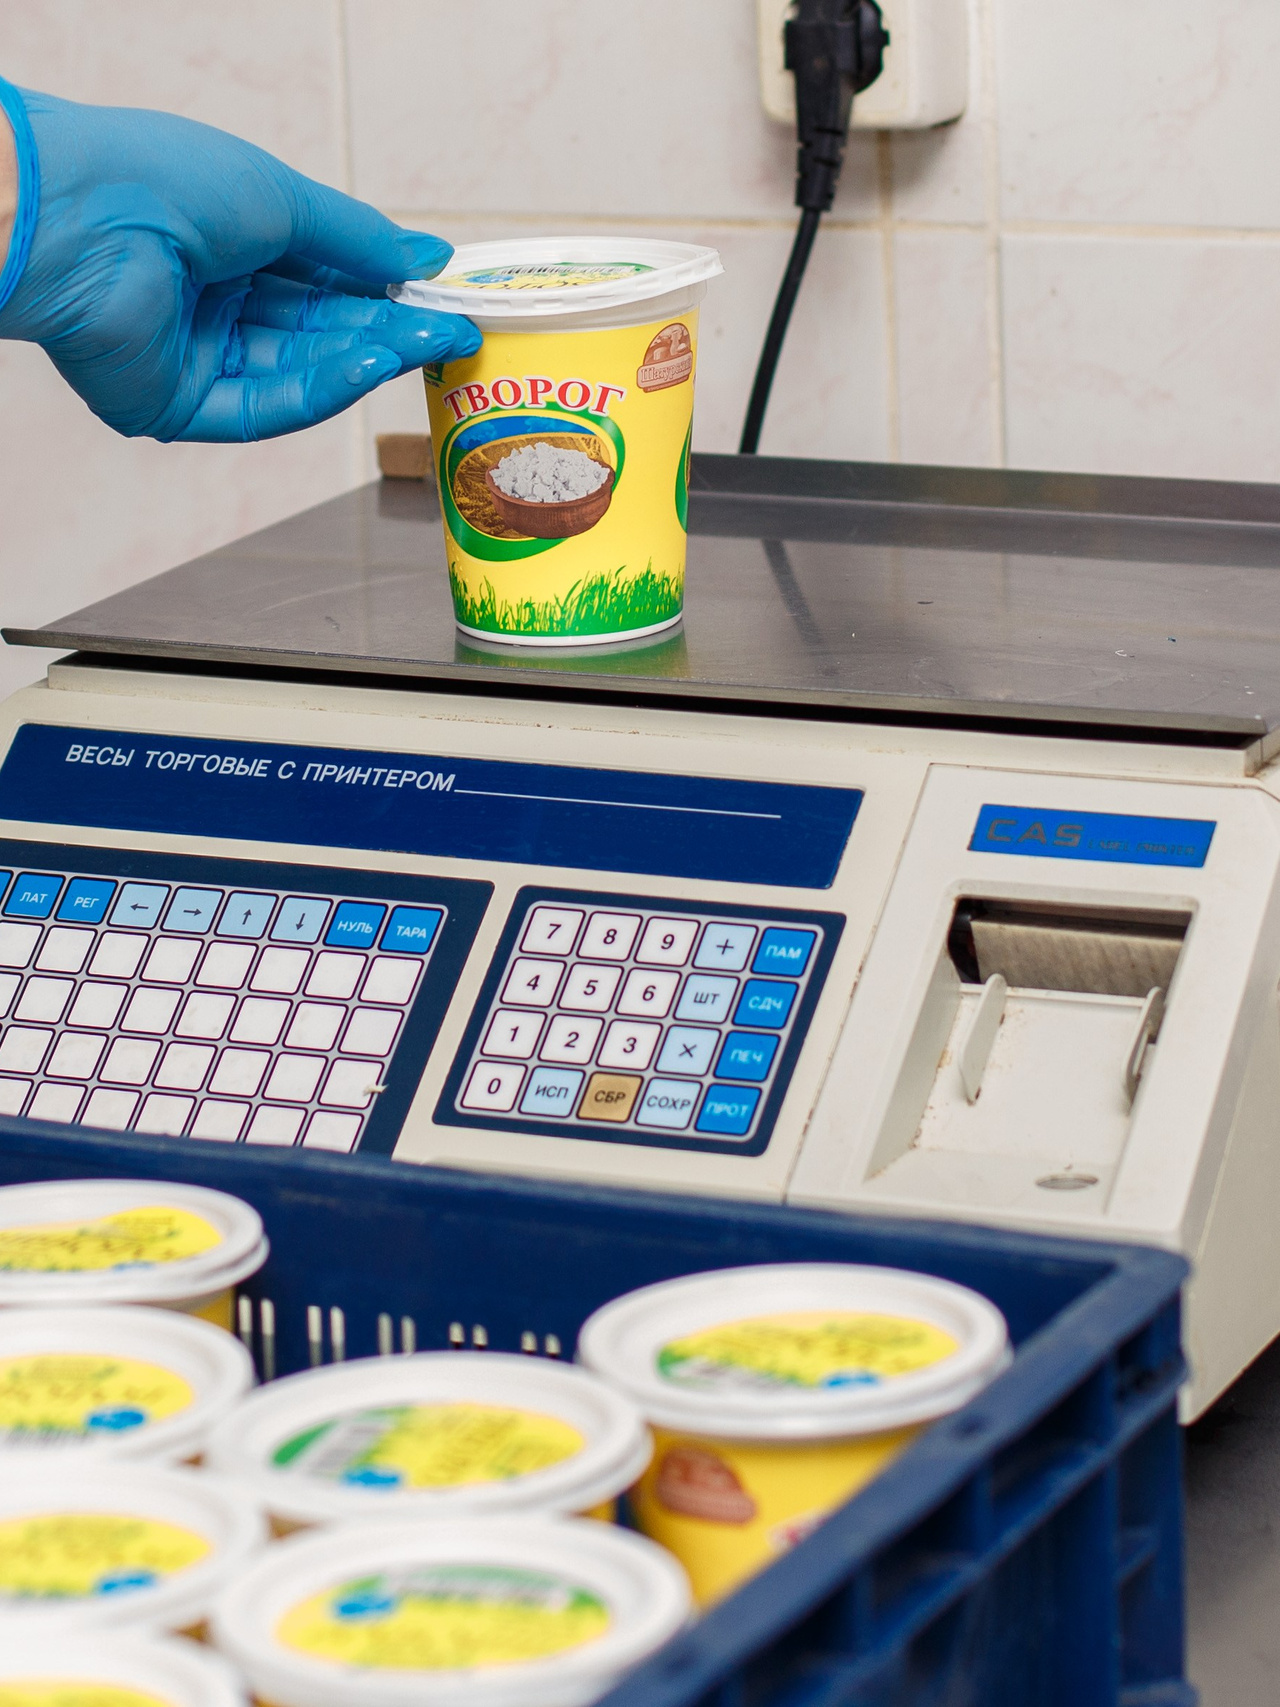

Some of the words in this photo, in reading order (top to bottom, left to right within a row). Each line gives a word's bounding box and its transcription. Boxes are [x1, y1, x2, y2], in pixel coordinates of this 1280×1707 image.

[442, 377, 625, 423] ТВОРОГ
[65, 744, 135, 767] ВЕСЫ
[145, 750, 272, 777] ТОРГОВЫЕ
[277, 760, 297, 780] С
[302, 763, 457, 792] ПРИНТЕРОМ
[986, 818, 1084, 847] CAS
[73, 896, 100, 908] РЕГ
[336, 919, 375, 934] НУЛЬ
[396, 925, 427, 939] ТАРА
[546, 923, 562, 940] 7
[602, 928, 618, 945] 8
[660, 933, 675, 950] 9
[765, 945, 802, 959] ПАМ
[526, 974, 541, 991] 4
[583, 979, 599, 996] 5
[642, 984, 657, 1002] 6
[693, 991, 720, 1005] ШТ
[748, 995, 783, 1011] СДЧ
[510, 1025, 520, 1042] 1
[563, 1031, 580, 1049] 2
[622, 1036, 638, 1054] 3
[730, 1049, 763, 1063] ПЕЧ
[534, 1085, 569, 1099] ИСП
[594, 1090, 626, 1104] СБР
[646, 1094, 692, 1112] СОХР
[705, 1102, 749, 1119] ПРОТ
